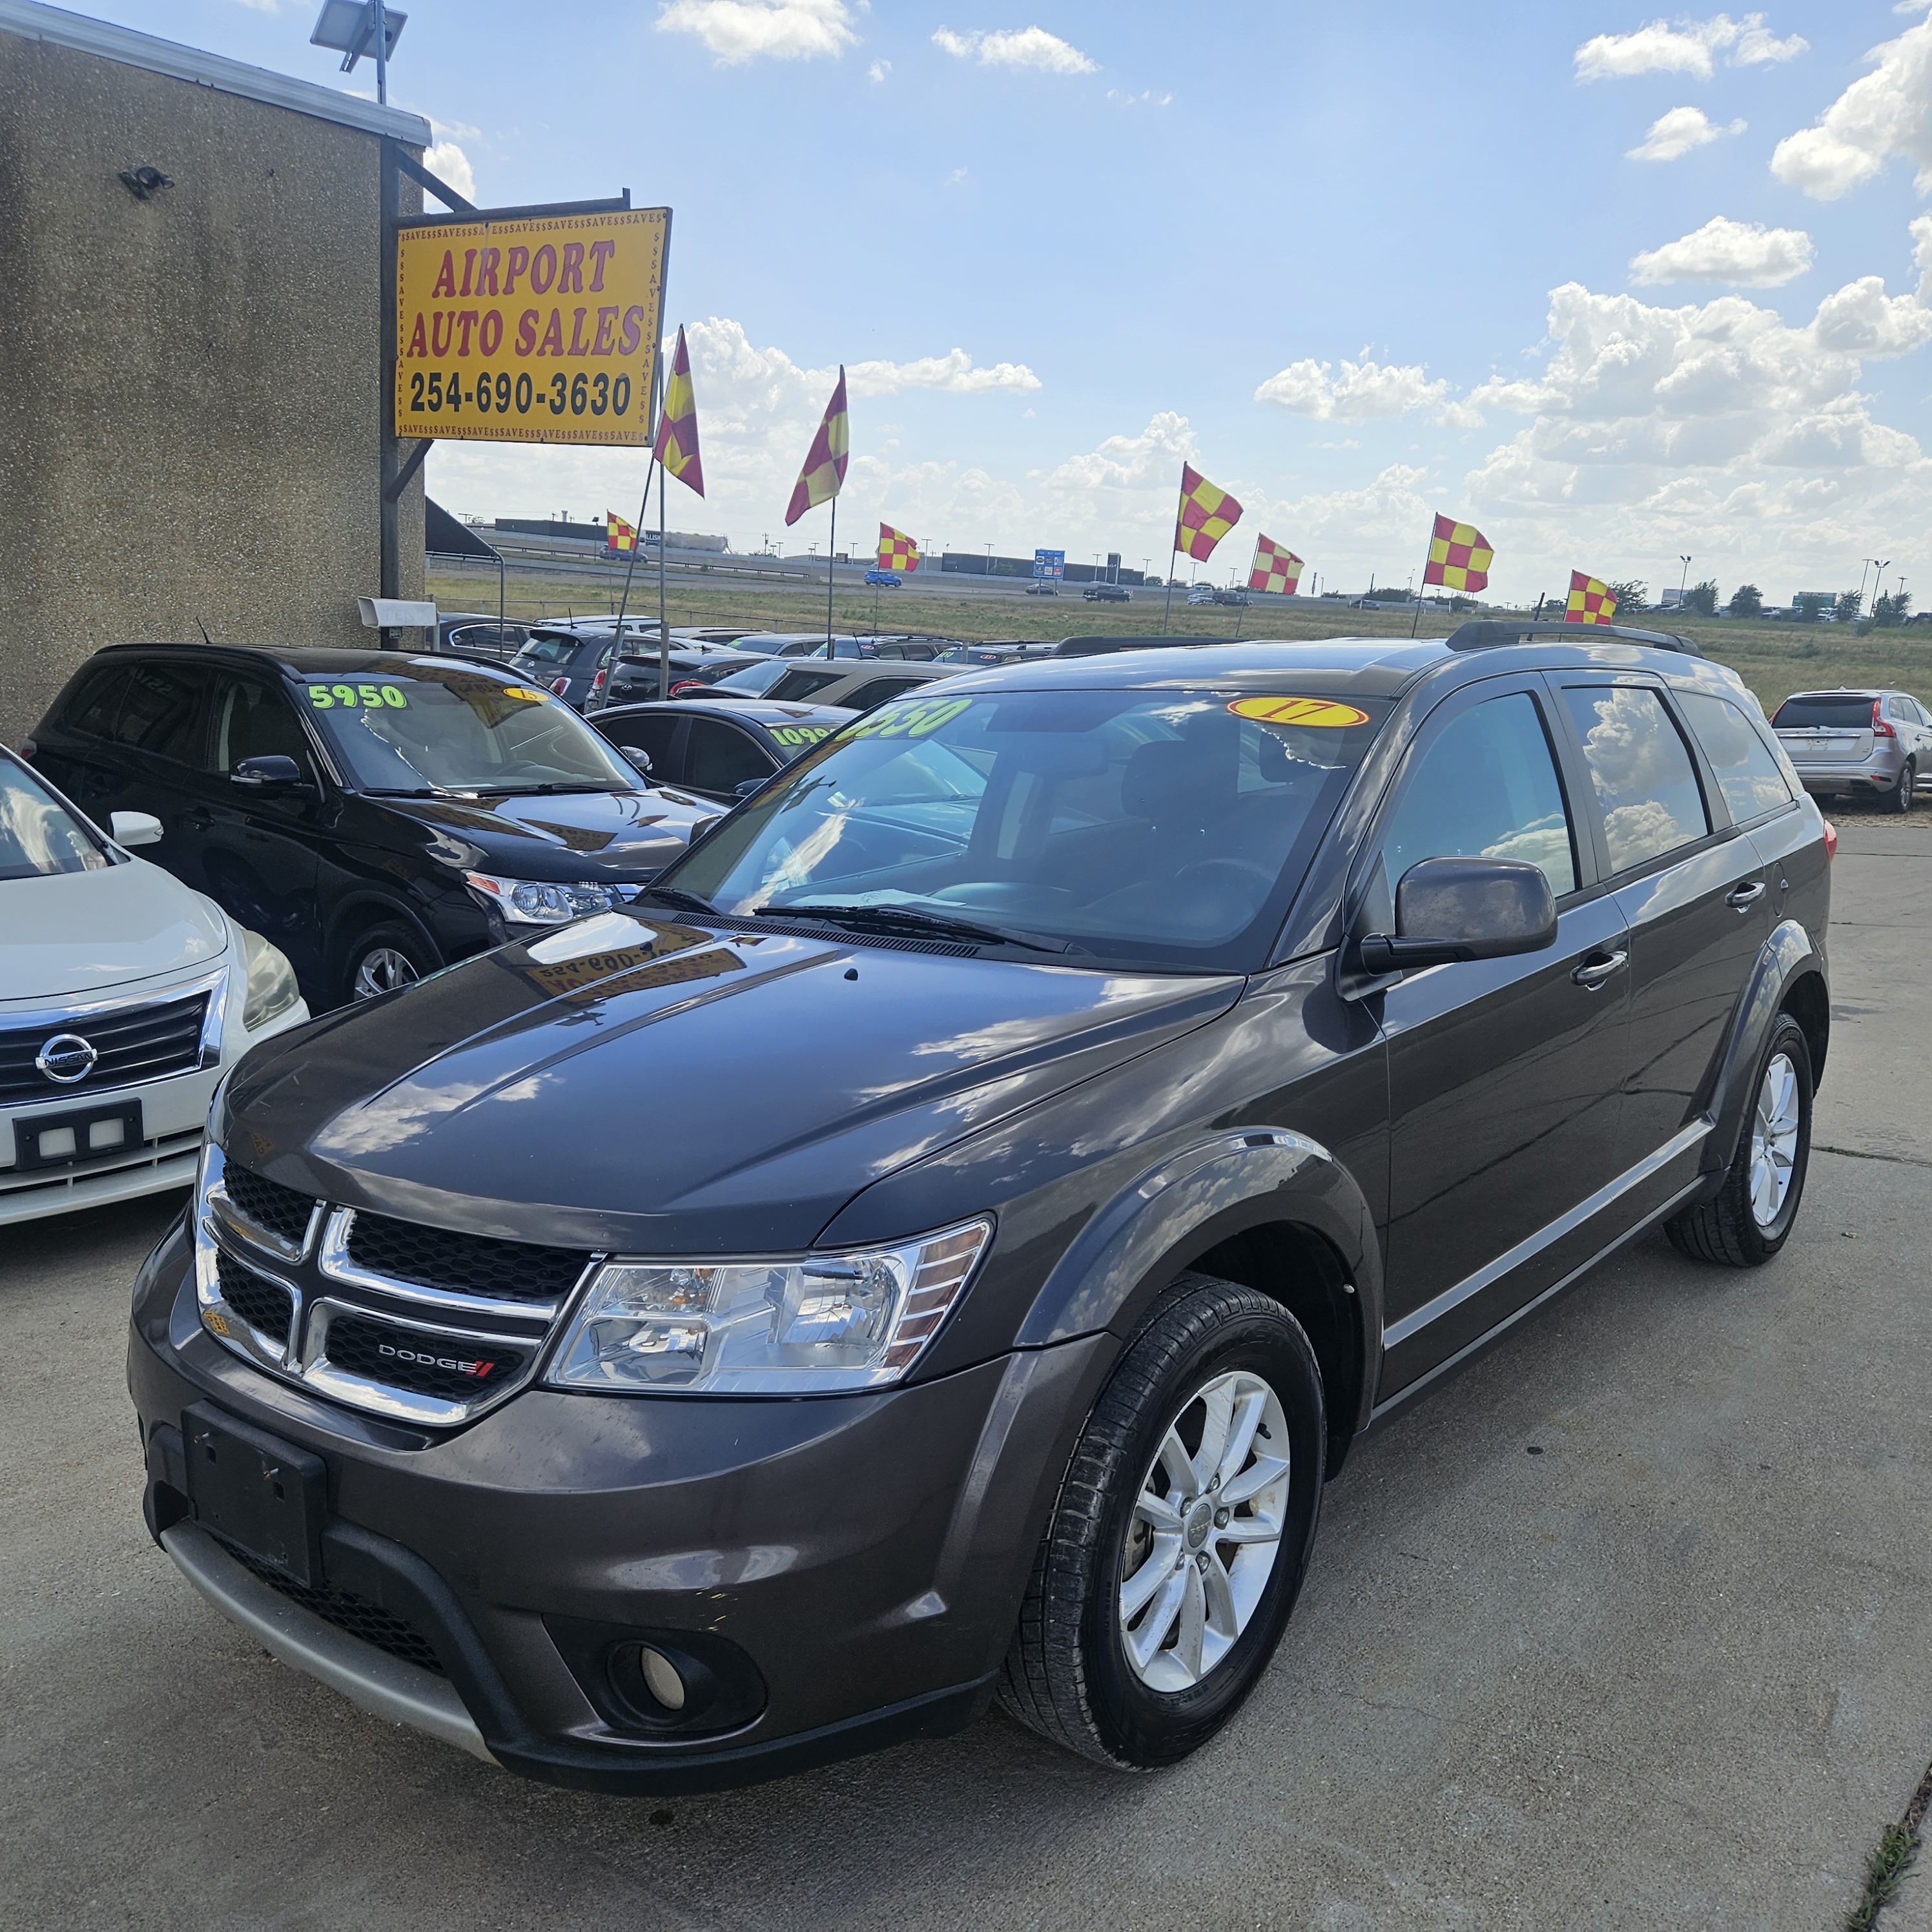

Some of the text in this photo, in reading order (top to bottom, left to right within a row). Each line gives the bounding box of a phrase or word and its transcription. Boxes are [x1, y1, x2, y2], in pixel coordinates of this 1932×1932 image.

[432, 240, 615, 298] AIRPORT
[406, 305, 644, 358] AUTO SALES
[410, 371, 632, 416] 254-690-3630
[308, 684, 407, 708] 5950
[1255, 700, 1339, 721] 17
[769, 728, 837, 746] 1099
[45, 1053, 93, 1066] NISSAN
[379, 1344, 477, 1373] DODGE
